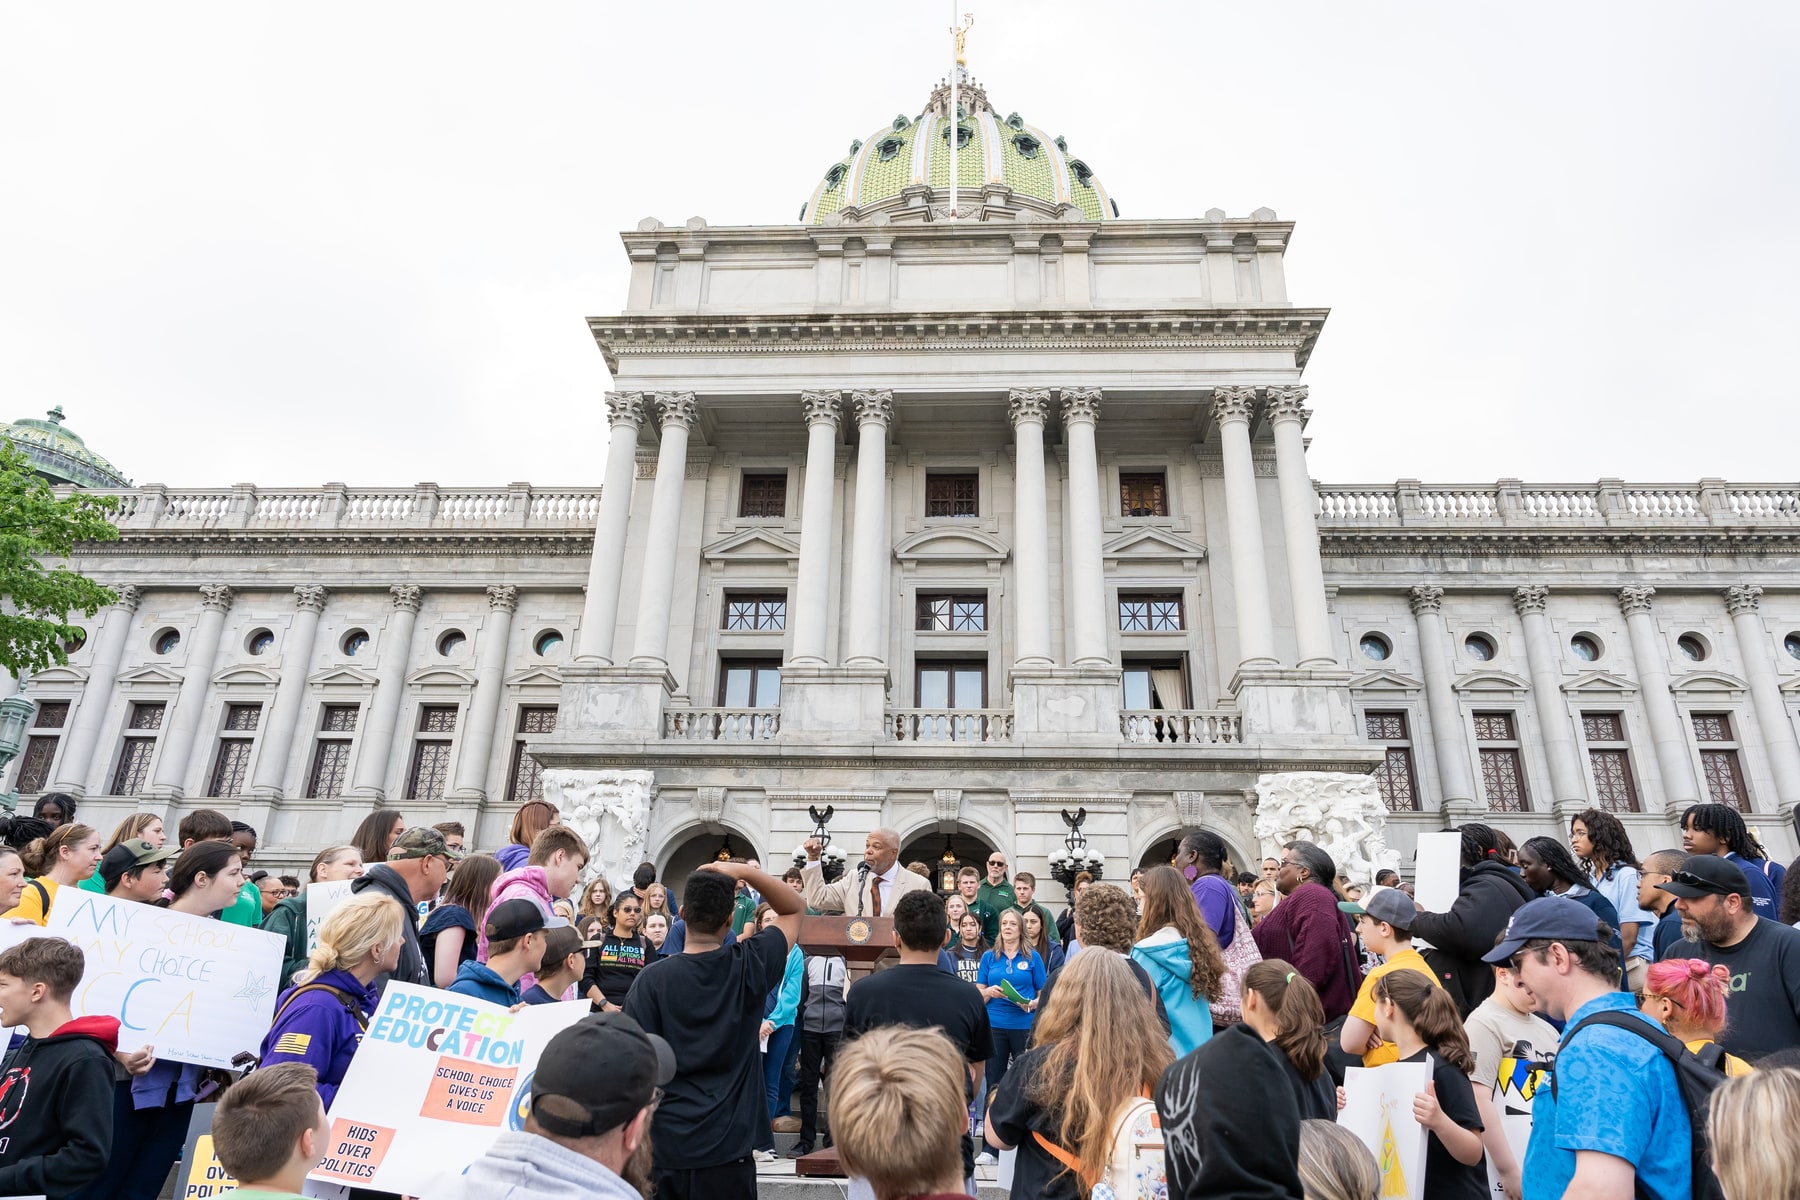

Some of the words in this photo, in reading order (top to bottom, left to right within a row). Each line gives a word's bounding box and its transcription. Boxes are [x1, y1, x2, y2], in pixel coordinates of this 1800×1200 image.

[67, 898, 140, 937] MY
[149, 914, 239, 951] SCHOOL
[620, 945, 639, 954] KIDS
[139, 947, 217, 982] CHOICE
[384, 992, 514, 1038] PROTECT
[370, 1015, 525, 1065] EDUCATION
[436, 1067, 475, 1083] SCHOOL
[479, 1075, 514, 1088] CHOICE
[448, 1084, 479, 1098] GIVES
[480, 1090, 494, 1100] US
[446, 1098, 452, 1109] A
[456, 1101, 485, 1113] VOICE
[346, 1125, 377, 1142] KIDS
[337, 1142, 371, 1159] OVER
[206, 1166, 236, 1180] OV
[316, 1157, 376, 1177] POLITICS
